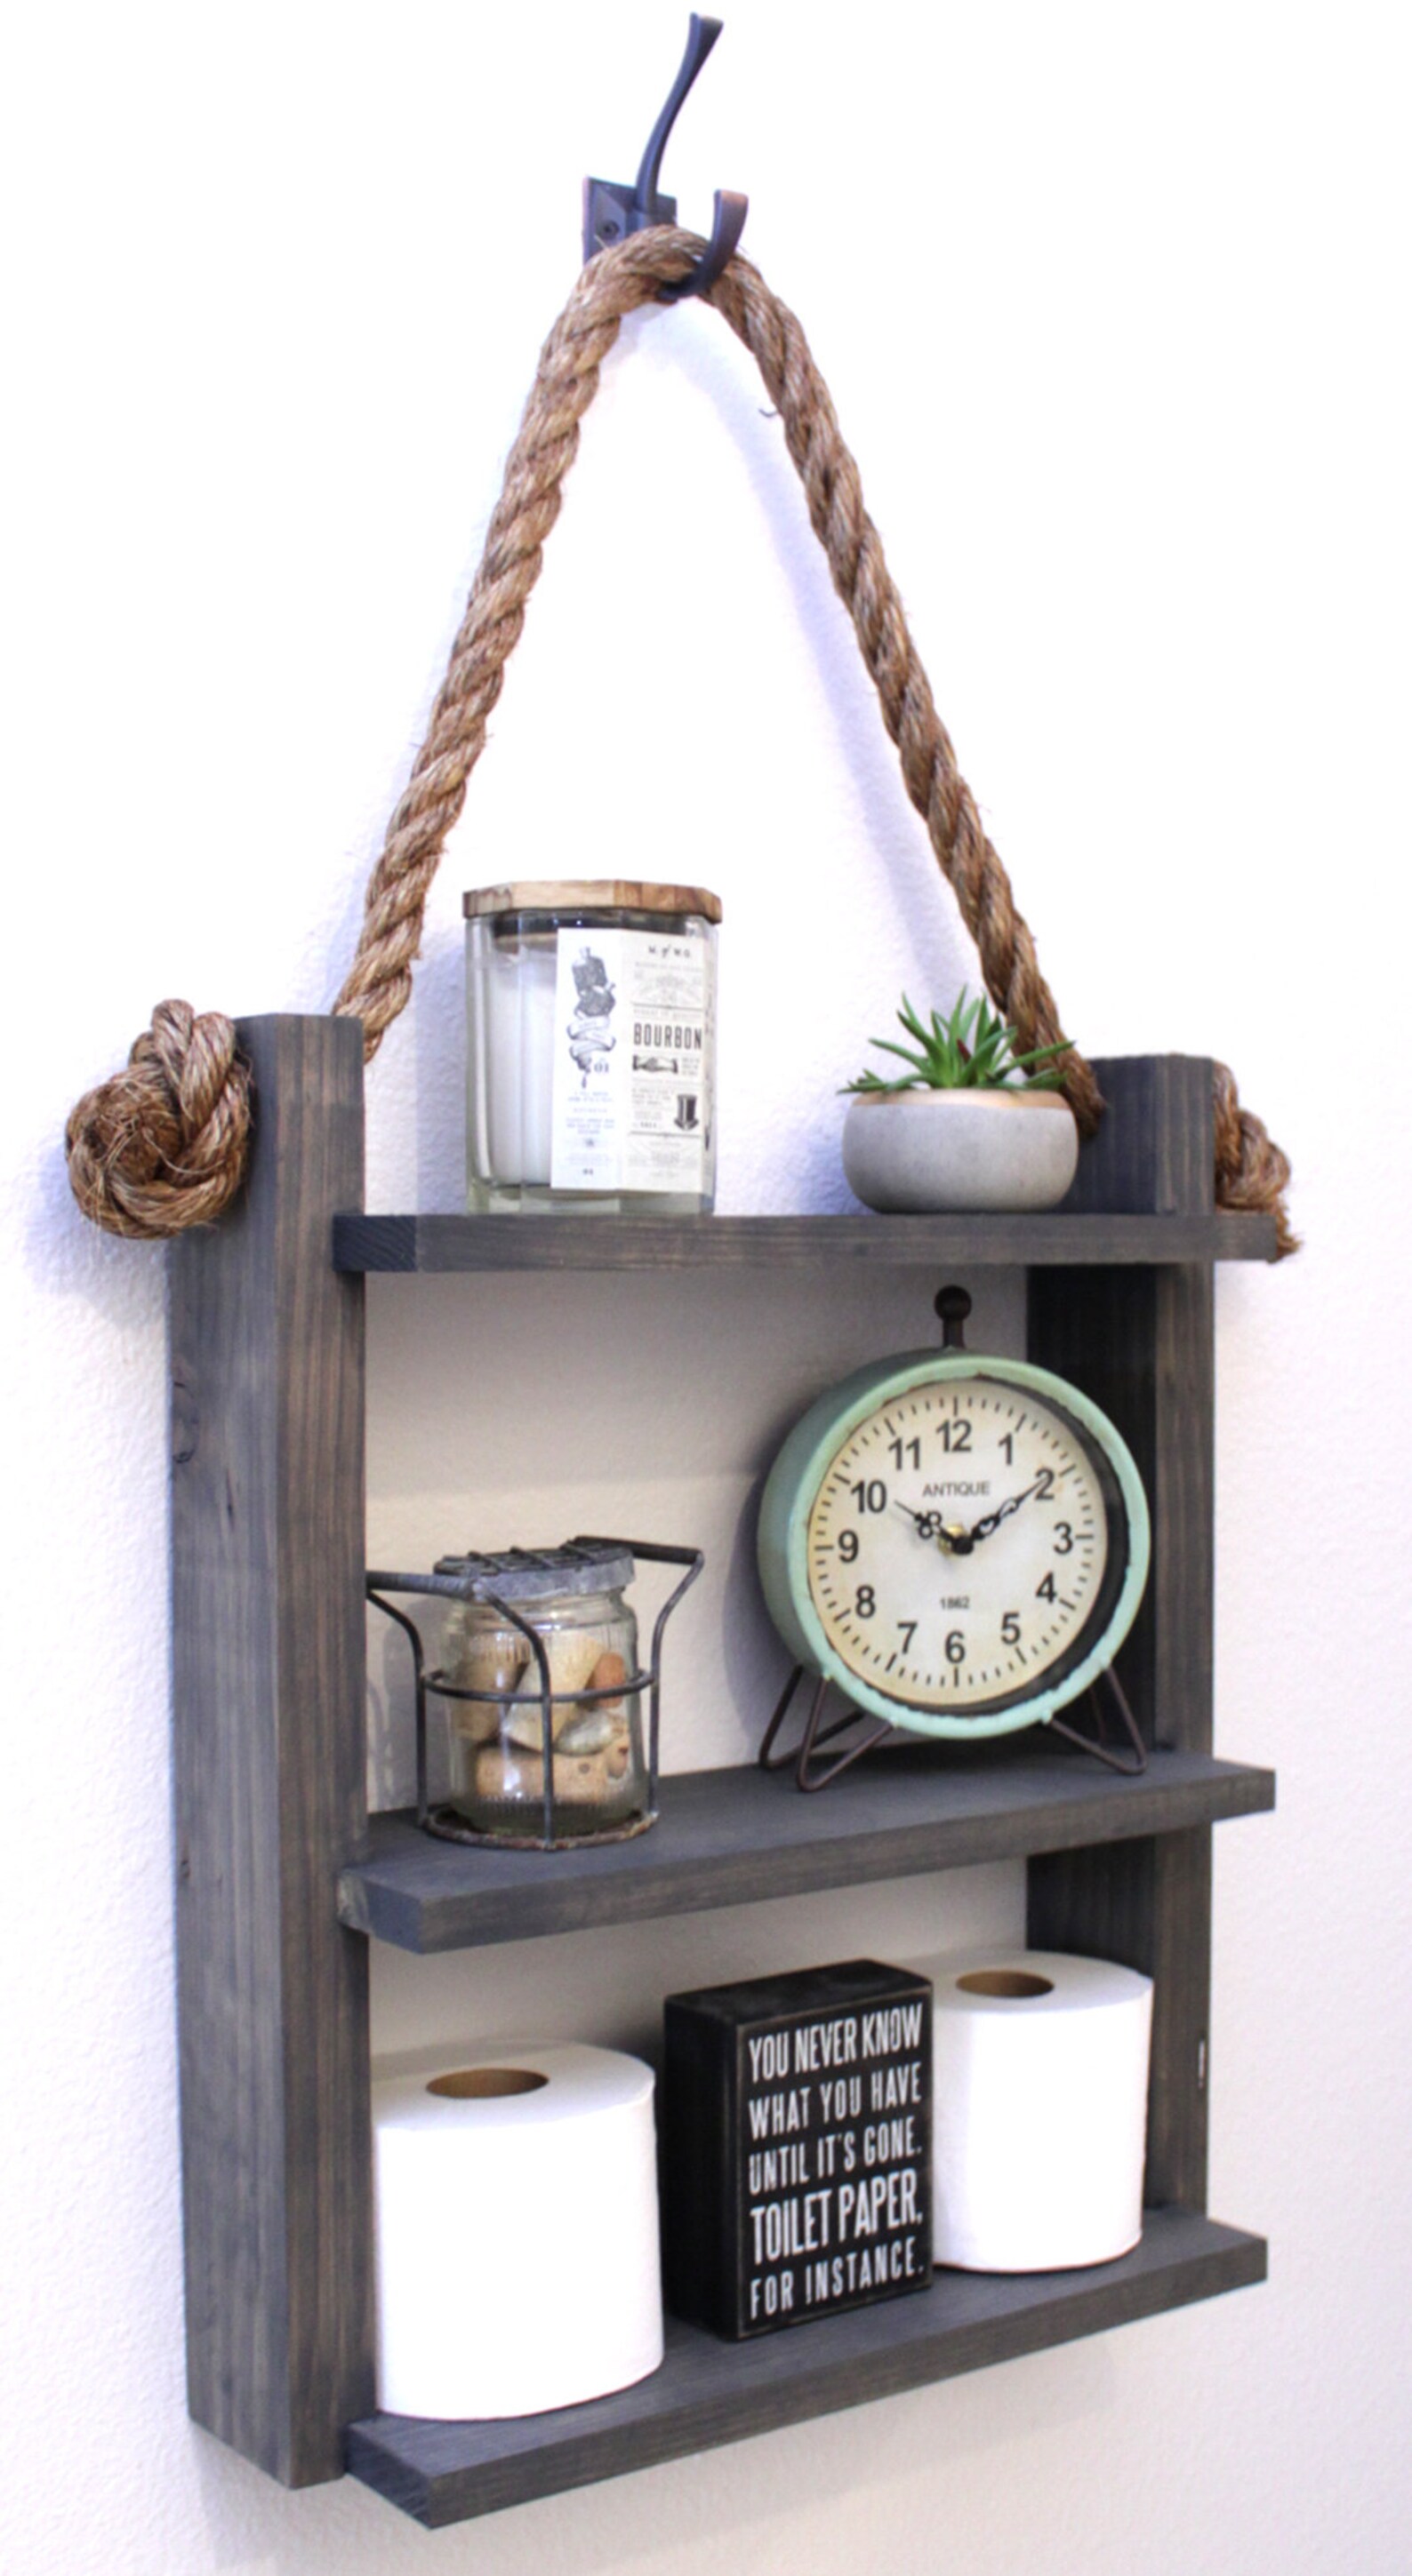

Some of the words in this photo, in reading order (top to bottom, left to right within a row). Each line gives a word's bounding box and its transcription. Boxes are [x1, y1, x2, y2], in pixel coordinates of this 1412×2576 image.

[633, 1022, 702, 1050] BOURBON
[936, 1420, 972, 1452] 12
[999, 1433, 1013, 1465] 1
[888, 1437, 920, 1470] 11
[851, 1480, 887, 1514] 10
[922, 1481, 991, 1497] ANTIQUE
[1035, 1468, 1055, 1500] 2
[838, 1530, 859, 1563] 9
[1054, 1522, 1073, 1555] 3
[855, 1585, 876, 1619] 8
[1035, 1572, 1057, 1604] 4
[897, 1622, 918, 1654] 7
[1001, 1612, 1021, 1644] 5
[945, 1631, 966, 1664] 6
[749, 2030, 790, 2084] YOU
[795, 2017, 857, 2074] NEVER
[862, 2002, 922, 2059] KNOW
[749, 2086, 810, 2140] WHAT
[820, 2075, 862, 2124] YOU
[870, 2061, 921, 2110] HAVE
[749, 2143, 810, 2195] UNTIL
[817, 2131, 855, 2178] IT'S
[863, 2116, 922, 2166] GONE.
[750, 2188, 832, 2265] TOILET
[750, 2270, 793, 2320] FOR
[806, 2236, 923, 2304] INSTANCE.
